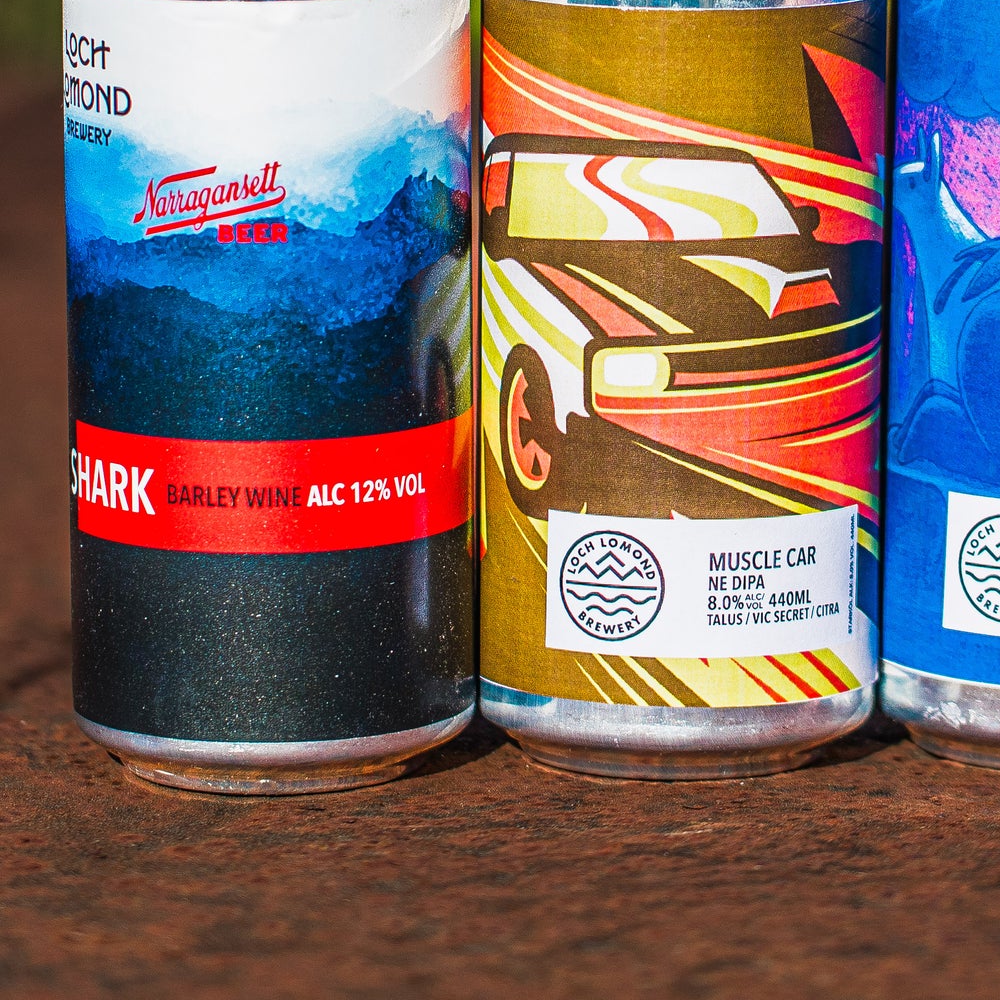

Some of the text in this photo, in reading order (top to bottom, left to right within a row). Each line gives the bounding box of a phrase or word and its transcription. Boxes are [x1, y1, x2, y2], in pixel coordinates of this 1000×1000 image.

[65, 29, 111, 70] LOCH
[65, 72, 133, 117] OMOND
[67, 117, 112, 146] BREWERY
[133, 160, 286, 236] Narragansett
[217, 224, 288, 244] BEER
[70, 447, 426, 515] SHARK BARLEY WINE ALC 12% VOL
[966, 523, 995, 556] LOCH
[567, 537, 656, 581] LOCH LOMOND
[709, 545, 816, 571] MUSCLE CAR
[708, 574, 765, 591] NE DIPA
[708, 594, 744, 610] 8.0%
[769, 589, 811, 607] 440ML
[746, 601, 763, 610] VOL
[578, 611, 641, 635] BREWERY
[707, 613, 743, 626] TALUS
[752, 611, 771, 624] VIC
[774, 607, 810, 623] SECRET
[816, 602, 840, 618] CITRA
